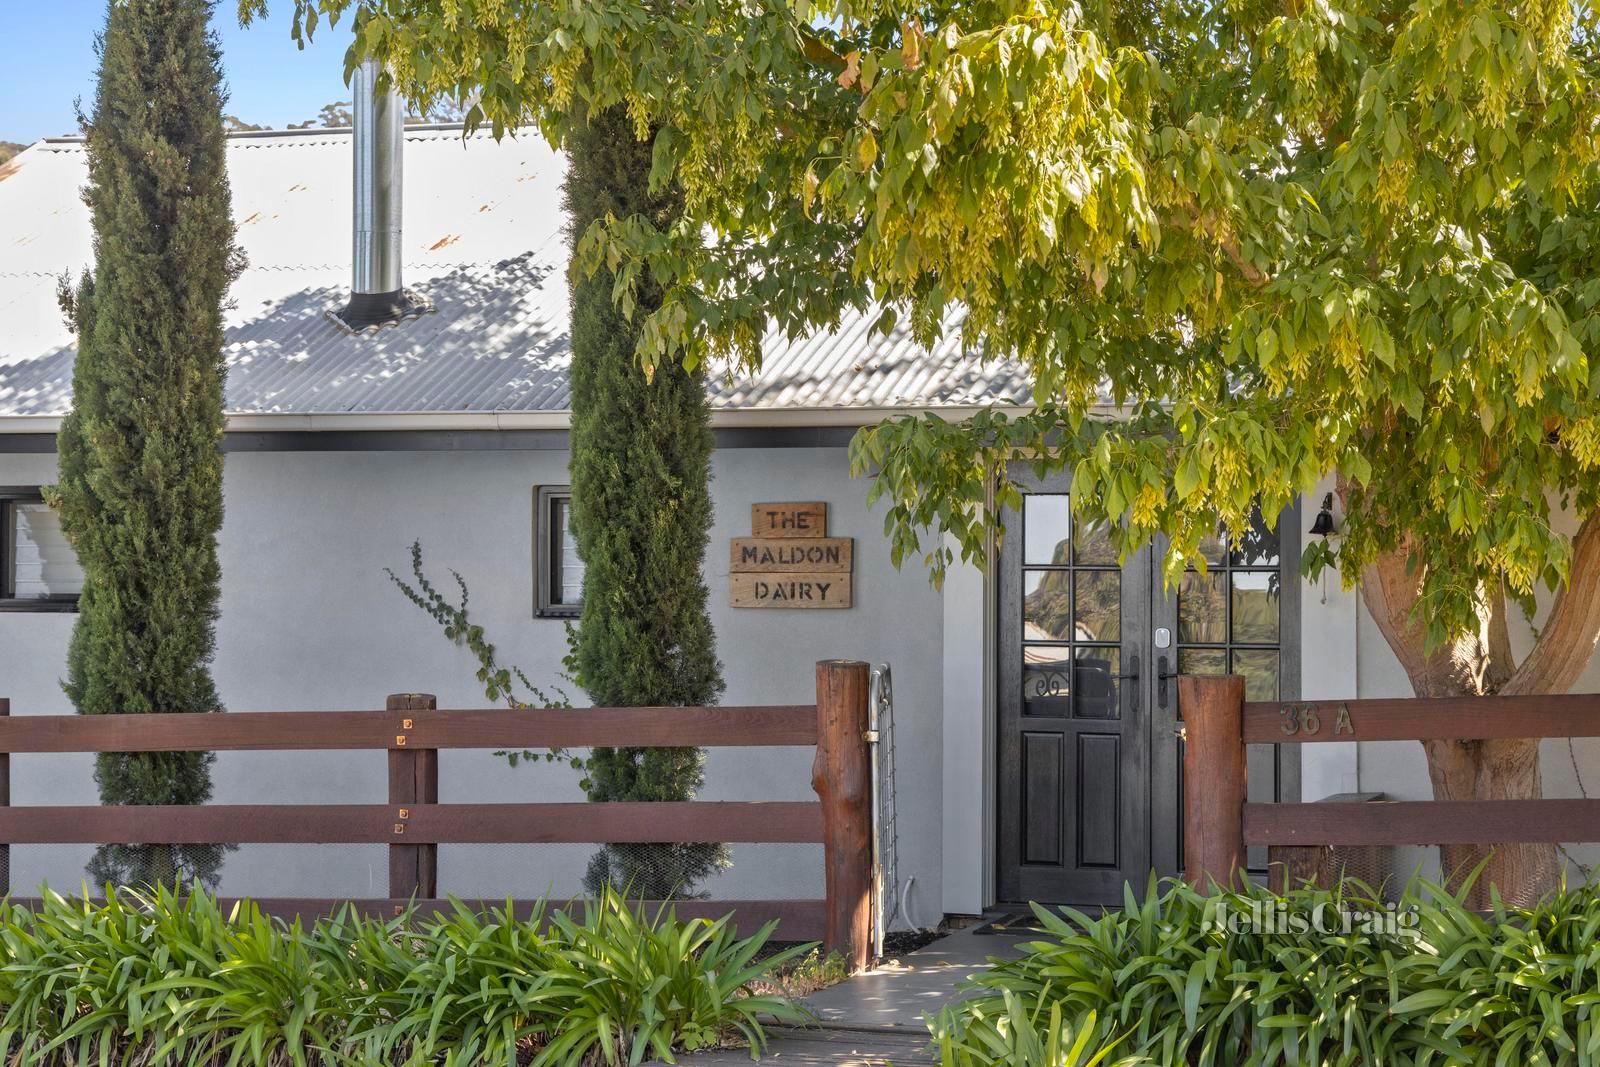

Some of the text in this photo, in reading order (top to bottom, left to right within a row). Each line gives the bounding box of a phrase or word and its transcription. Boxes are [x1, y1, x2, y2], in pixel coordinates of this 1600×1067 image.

[766, 511, 811, 529] THE
[741, 546, 840, 565] MALDON
[754, 581, 832, 601] DAIRY
[1280, 702, 1355, 736] 36 A
